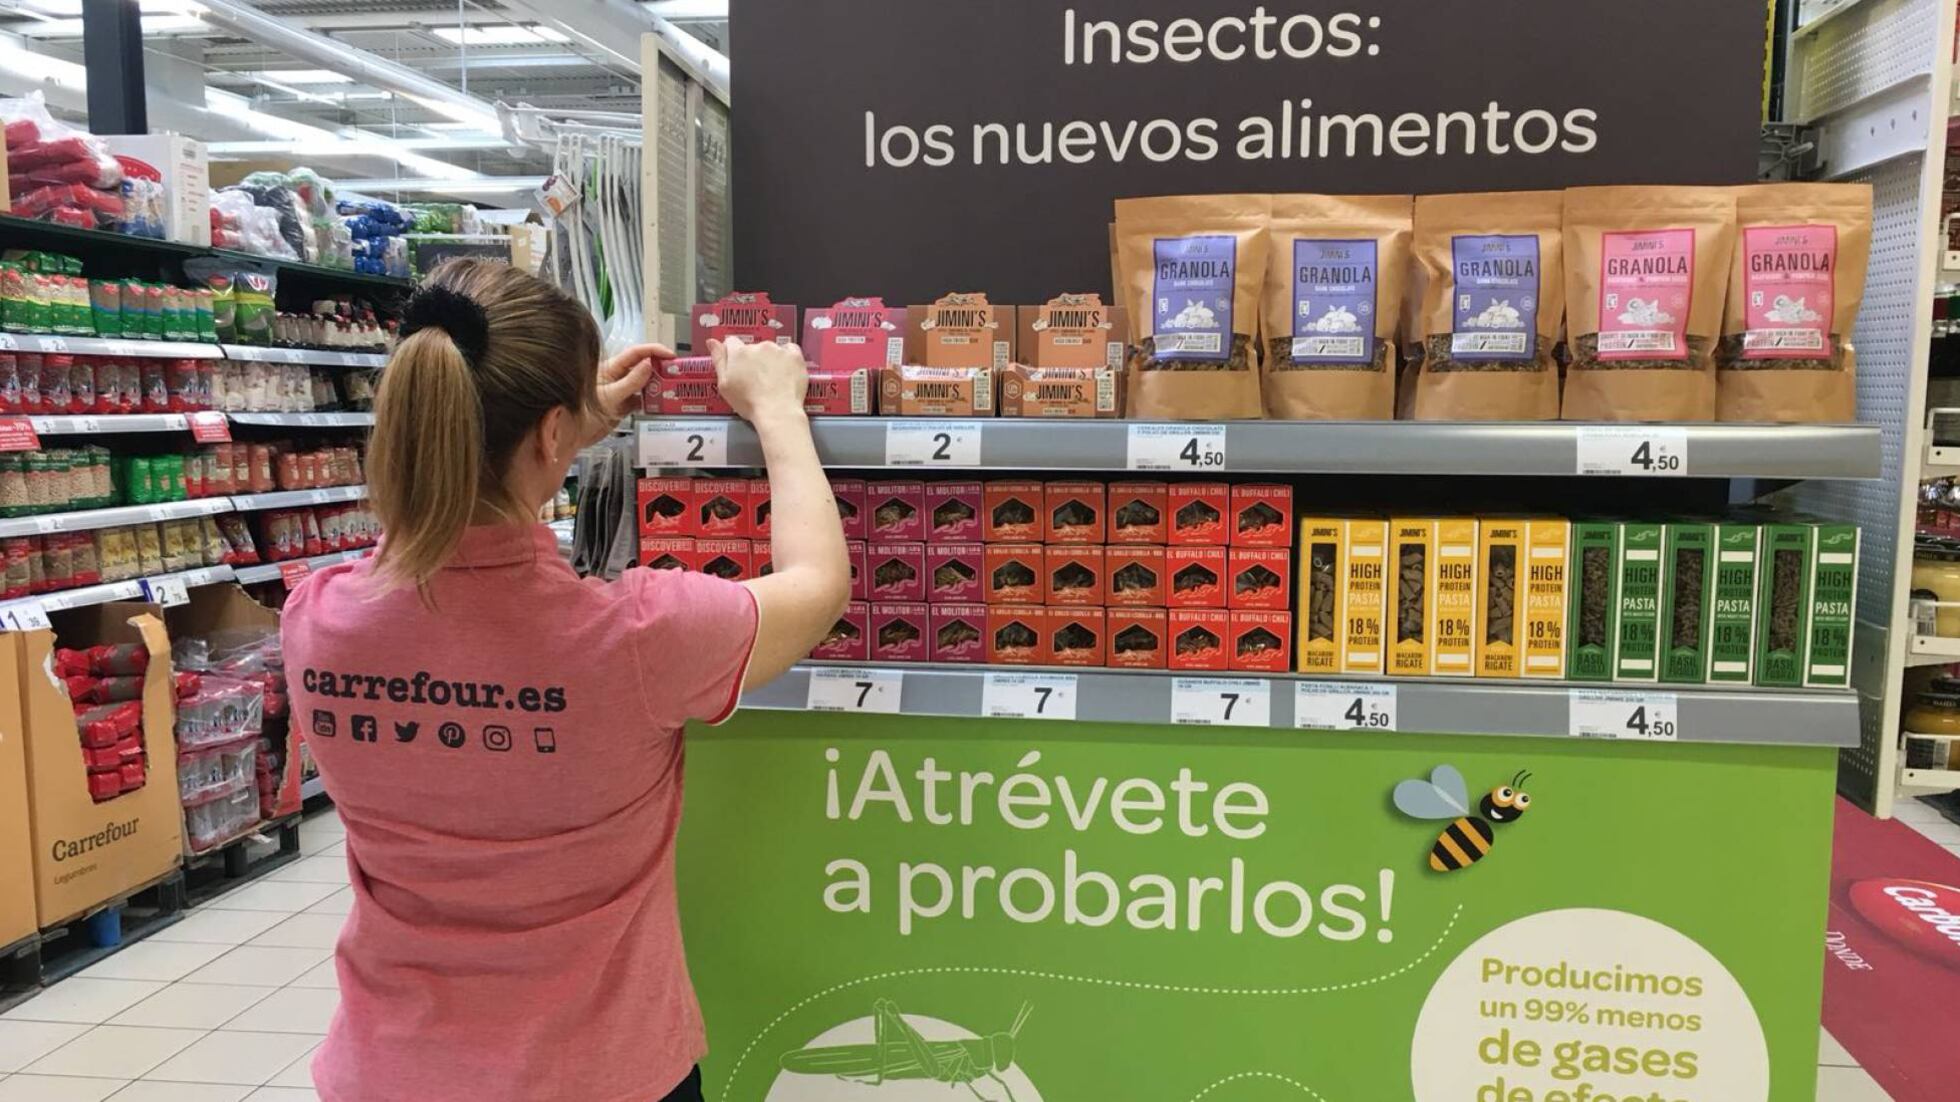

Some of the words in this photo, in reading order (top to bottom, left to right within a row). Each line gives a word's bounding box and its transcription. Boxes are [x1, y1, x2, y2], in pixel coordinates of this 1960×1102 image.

[1064, 7, 1382, 65] Insectos:
[865, 111, 955, 167] los
[972, 117, 1219, 165] nuevos
[1235, 98, 1599, 160] alimentos
[1160, 260, 1230, 281] GRANOLA
[1460, 259, 1535, 277] GRANOLA
[1608, 256, 1688, 276] GRANOLA
[1751, 253, 1830, 273] GRANOLA
[1299, 266, 1372, 284] GRANOLA
[719, 308, 769, 326] JIMINI'S
[831, 311, 882, 328] JIMINI'S
[935, 309, 987, 328] JIMINI'S
[1047, 310, 1100, 328] JIMINI'S
[914, 383, 960, 399] JIMINI'S
[1036, 384, 1083, 400] JIMINI'S
[687, 434, 705, 462] 2
[932, 433, 952, 461] 2
[1179, 438, 1224, 468] 4,50
[1631, 441, 1679, 472] 4,50
[695, 482, 735, 493] DISCOVER
[868, 486, 876, 494] EL
[878, 486, 905, 494] MOLITOR
[927, 486, 934, 495] EL
[937, 486, 965, 495] MOLITOR
[1169, 487, 1176, 496] EL
[1179, 487, 1206, 496] BUFFALO
[1232, 489, 1239, 498] EL
[1241, 489, 1269, 498] BUFFALO
[697, 542, 737, 553] DISCOVER
[869, 546, 876, 554] EL
[878, 546, 906, 554] MOLITOR
[928, 546, 935, 555] EL
[937, 546, 966, 555] MOLITOR
[1167, 550, 1174, 559] EL
[1176, 550, 1203, 559] BUFFALO
[1230, 551, 1237, 560] EL
[1239, 551, 1266, 560] BUFFALO
[1351, 563, 1381, 579] HIGH
[1440, 564, 1471, 579] HIGH
[1531, 565, 1563, 580] HIGH
[1625, 567, 1657, 584] HIGH
[1719, 569, 1752, 585] HIGH
[1818, 571, 1850, 587] HIGH
[1350, 582, 1381, 590] PROTEIN
[1439, 582, 1470, 591] PROTEIN
[1530, 584, 1562, 592] PROTEIN
[156, 586, 168, 604] 2
[1350, 593, 1380, 605] PASTA
[1439, 593, 1470, 605] PASTA
[1529, 595, 1561, 607] PASTA
[872, 606, 880, 615] EL
[882, 606, 910, 615] MOLITOR
[932, 607, 939, 616] EL
[941, 607, 970, 616] MOLITOR
[1623, 598, 1655, 610] PASTA
[1717, 600, 1750, 612] PASTA
[1815, 602, 1848, 614] PASTA
[8, 610, 21, 630] 1
[1169, 612, 1176, 621] EL
[1179, 612, 1206, 621] BUFFALO
[1231, 614, 1238, 623] EL
[1240, 614, 1268, 623] BUFFALO
[1348, 636, 1379, 645] PROTEIN
[1438, 637, 1469, 646] PROTEIN
[1528, 640, 1560, 648] PROTEIN
[1307, 657, 1333, 667] RIGATE
[1396, 658, 1423, 668] RIGATE
[1485, 660, 1512, 671] RIGATE
[303, 668, 567, 712] carrefour.es
[856, 682, 873, 707] 7
[1034, 687, 1052, 713] 7
[1221, 693, 1239, 720] 7
[1626, 705, 1674, 737] 4,50
[825, 747, 1269, 840] ¡Atrévete
[52, 817, 139, 862] Carrefour
[823, 858, 871, 913] a
[899, 849, 1395, 944] probarlos!
[1481, 957, 1703, 997] Producimos
[1480, 1000, 1517, 1020] un
[1524, 998, 1590, 1025] 99%
[1597, 1006, 1702, 1032] menos
[1478, 1028, 1541, 1067] de
[1551, 1040, 1698, 1080] gases
